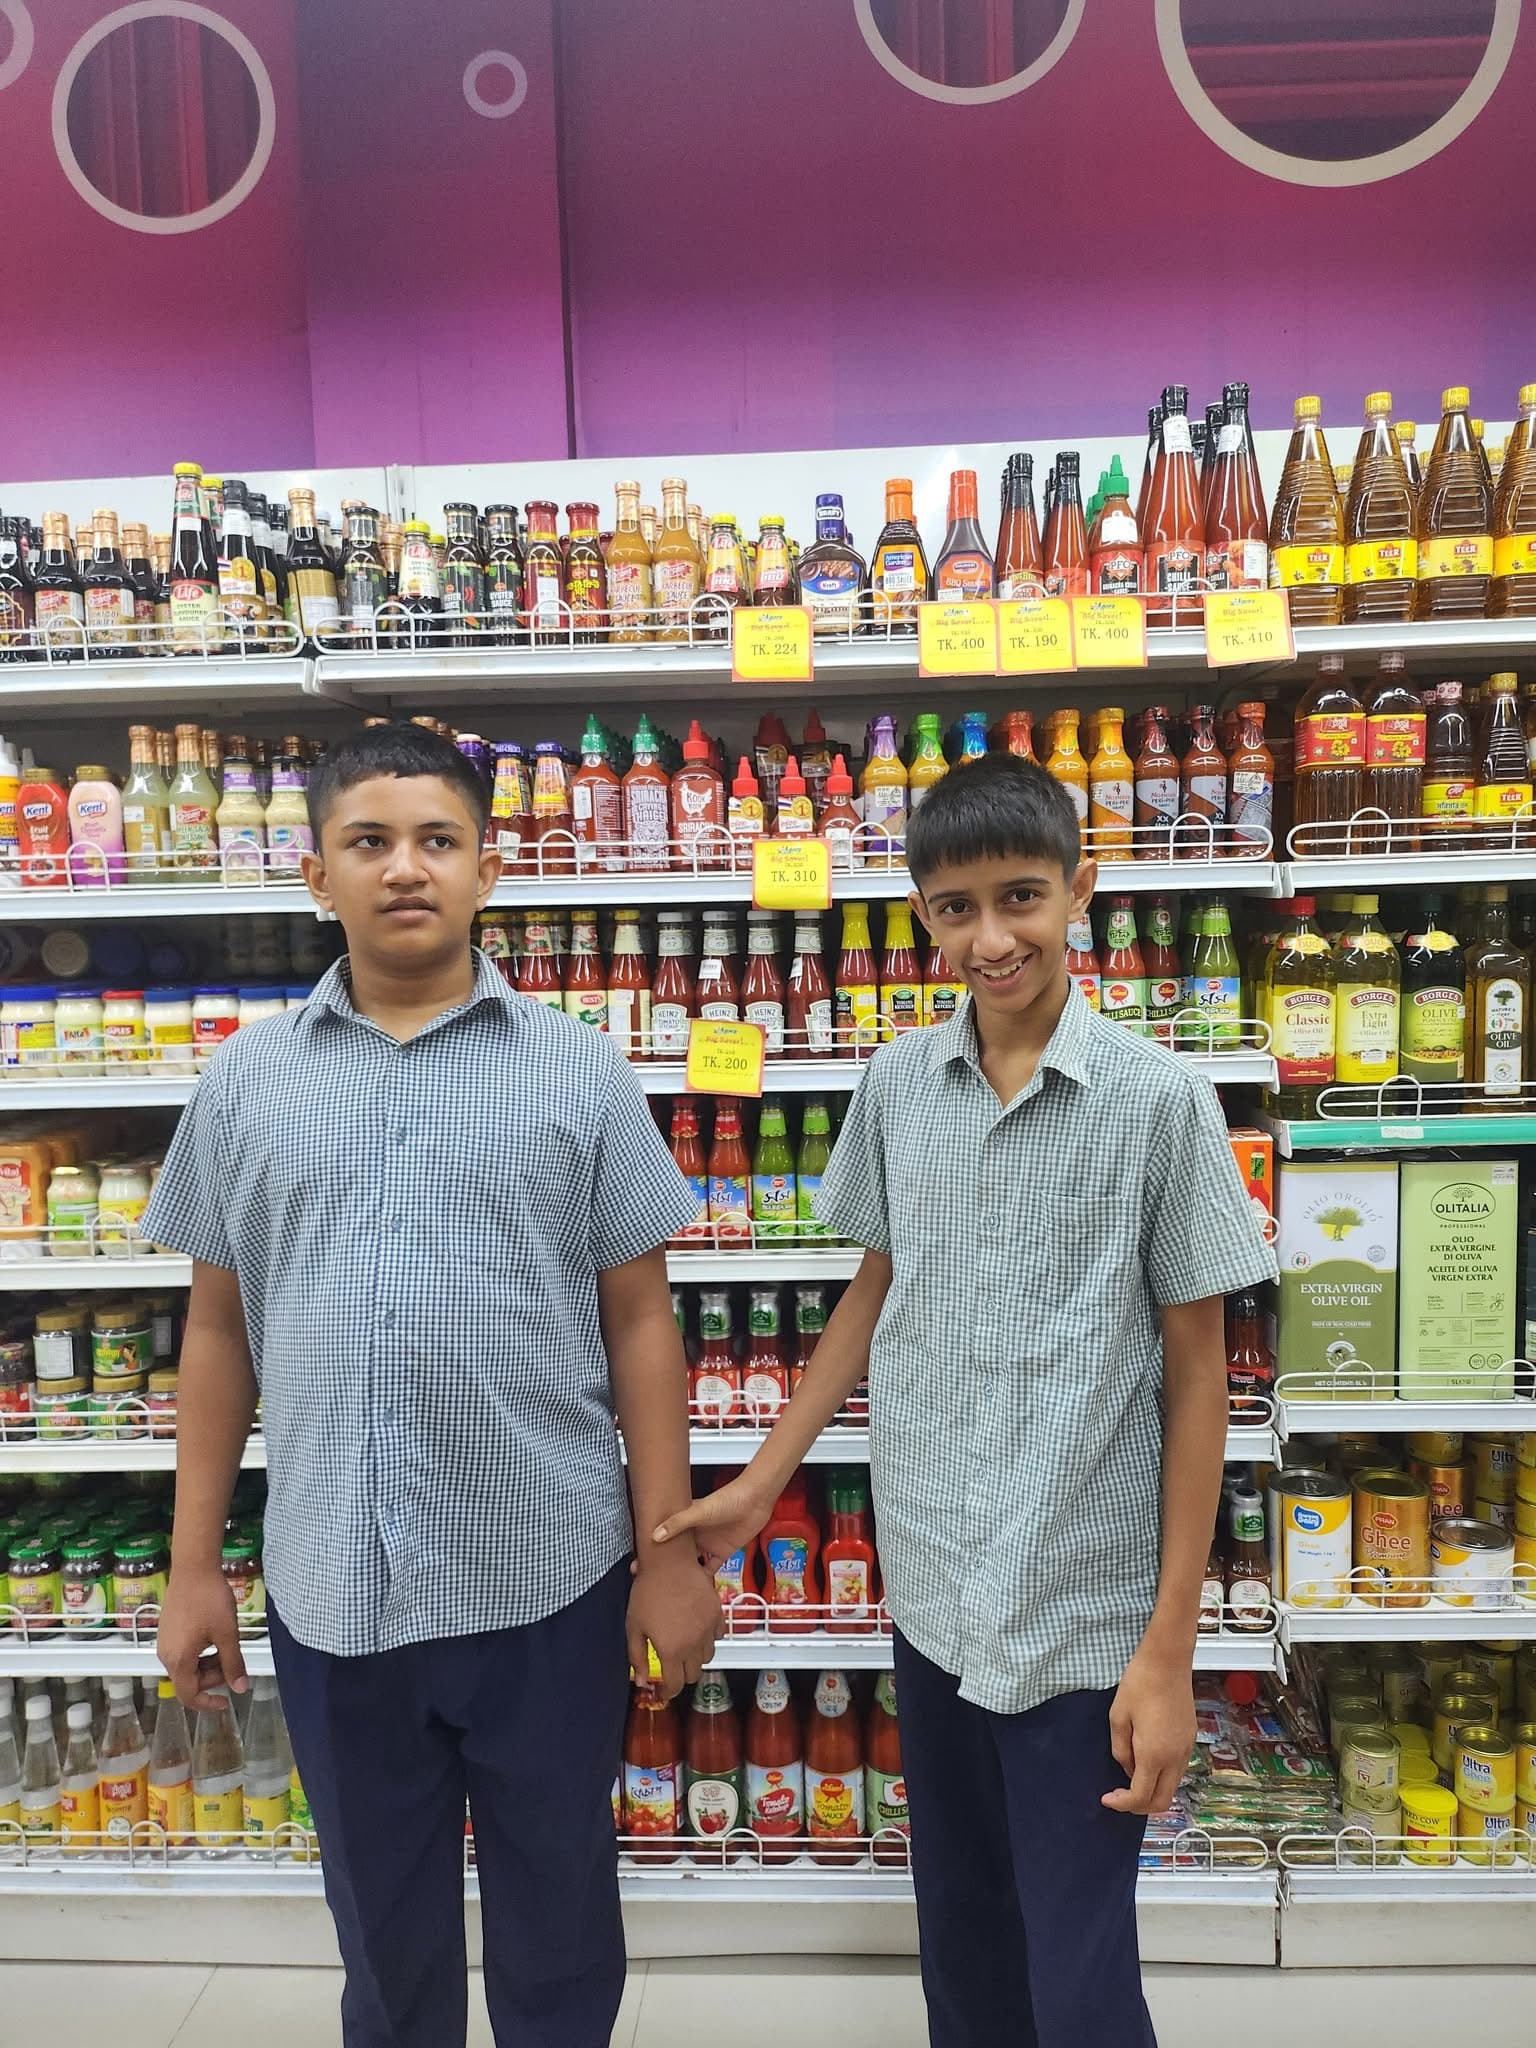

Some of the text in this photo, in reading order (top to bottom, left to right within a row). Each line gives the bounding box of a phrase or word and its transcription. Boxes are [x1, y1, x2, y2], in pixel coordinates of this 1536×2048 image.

[1380, 549, 1400, 558] TEER
[1454, 545, 1476, 554] TEER
[1310, 554, 1329, 562] TEER
[946, 578, 961, 586] BBQ
[1167, 572, 1190, 582] CHILLI
[178, 586, 199, 600] Life
[1081, 628, 1129, 639] TK. 400
[937, 637, 985, 650] TK. 400
[1010, 635, 1058, 648] TK. 190
[1222, 632, 1273, 647] TK. 410
[752, 644, 797, 656] TK. 224
[0, 805, 16, 813] ent
[26, 806, 49, 816] Kent
[80, 804, 103, 814] Kent
[749, 806, 755, 816] 1
[800, 805, 806, 816] 1
[771, 870, 817, 882] TK. 310
[1291, 993, 1327, 1004] BORGES
[1357, 992, 1393, 1003] BORGES
[1422, 992, 1458, 1002] BORGES
[658, 1010, 679, 1018] HEINZ
[709, 1009, 731, 1017] HEINZ
[754, 1008, 776, 1017] HEINZ
[1120, 1008, 1141, 1018] SAUCE
[1362, 1011, 1388, 1019] Extra
[1423, 1009, 1457, 1017] OLIVE
[1286, 1014, 1329, 1026] Classic
[1362, 1020, 1387, 1029] Light
[703, 1056, 748, 1070] TK. 200
[1304, 1195, 1329, 1220] OLIO
[1435, 1203, 1490, 1213] OLITALIA
[1460, 1244, 1496, 1252] VERGINE
[1432, 1274, 1464, 1282] VIRGEN
[1301, 1283, 1382, 1293] EXTRA VIRGIN
[1312, 1296, 1371, 1306] OLIVE OIL
[1432, 1501, 1463, 1516] hee
[1362, 1527, 1411, 1549] Ghee
[1462, 1755, 1490, 1773] Ultra
[1464, 1767, 1491, 1782] Ghee
[879, 1807, 900, 1816] CHILLI
[1405, 1811, 1418, 1823] RED
[1420, 1817, 1440, 1825] COW
[1485, 1817, 1510, 1829] Ultra
